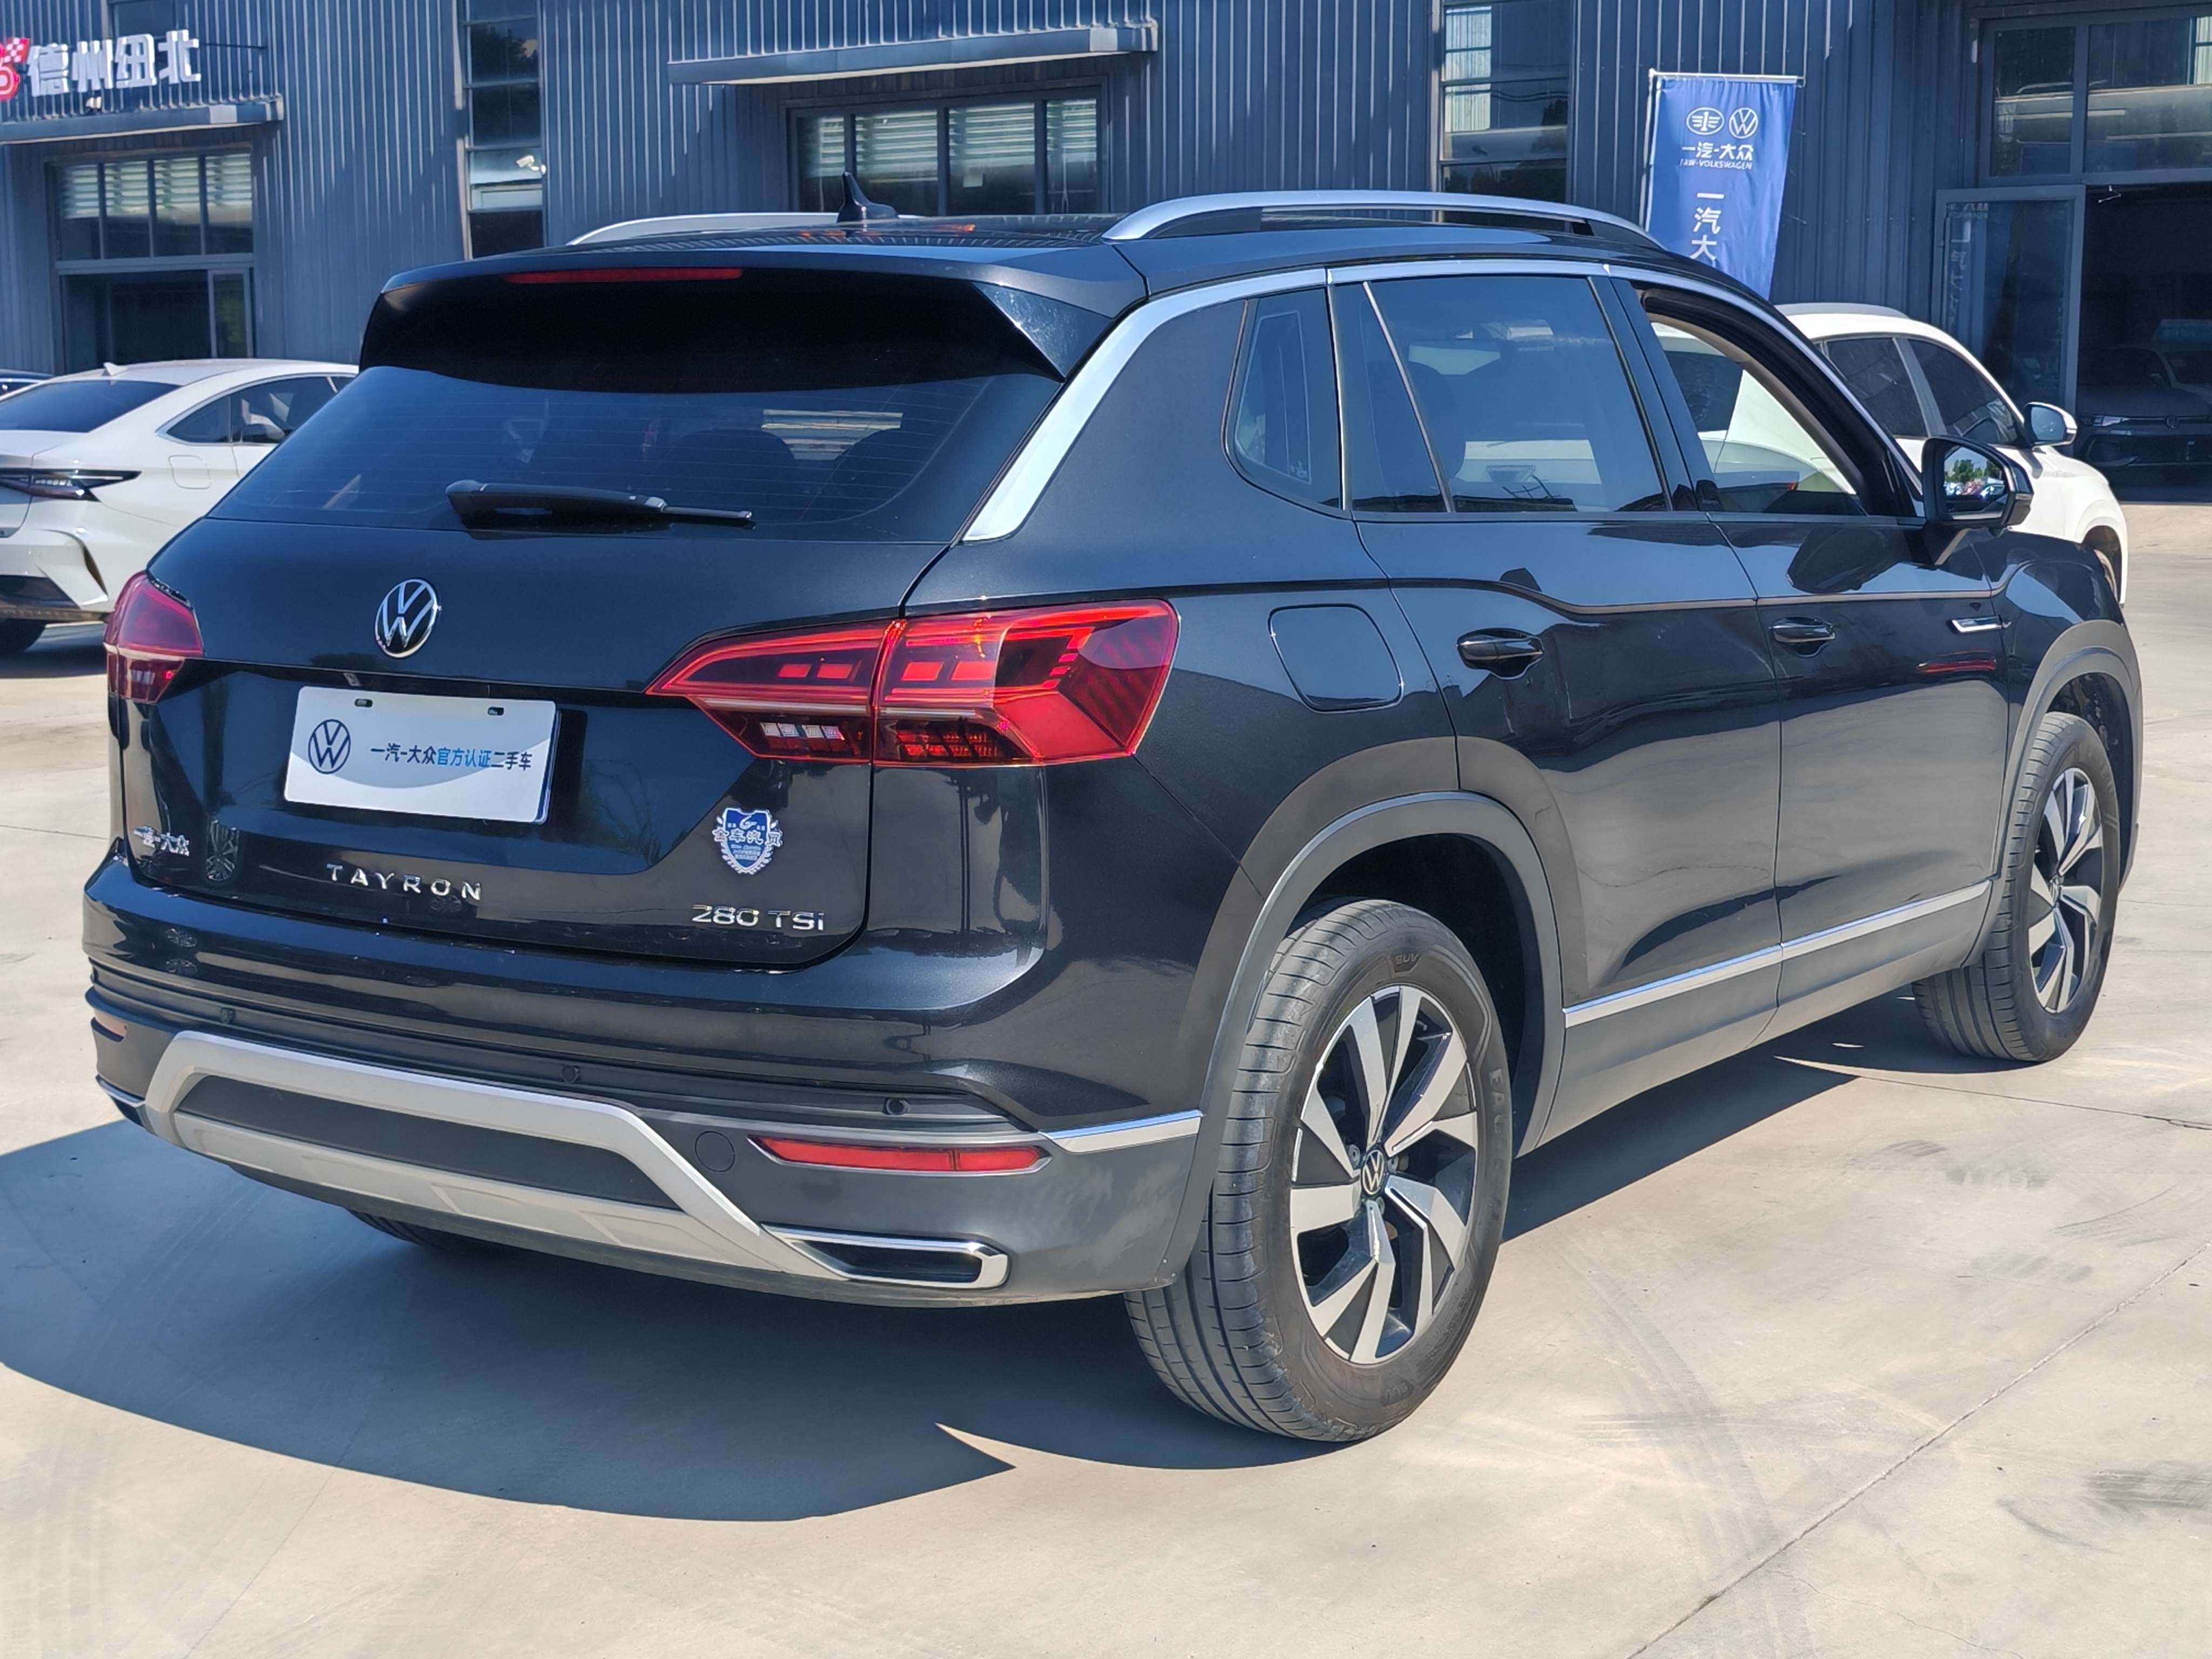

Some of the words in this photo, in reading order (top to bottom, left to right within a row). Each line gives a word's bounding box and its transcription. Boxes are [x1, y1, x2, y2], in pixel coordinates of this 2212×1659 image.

[370, 743, 534, 771] 一汽-大众官方认证二手车
[326, 863, 483, 901] TAYRON
[692, 905, 760, 927] 280
